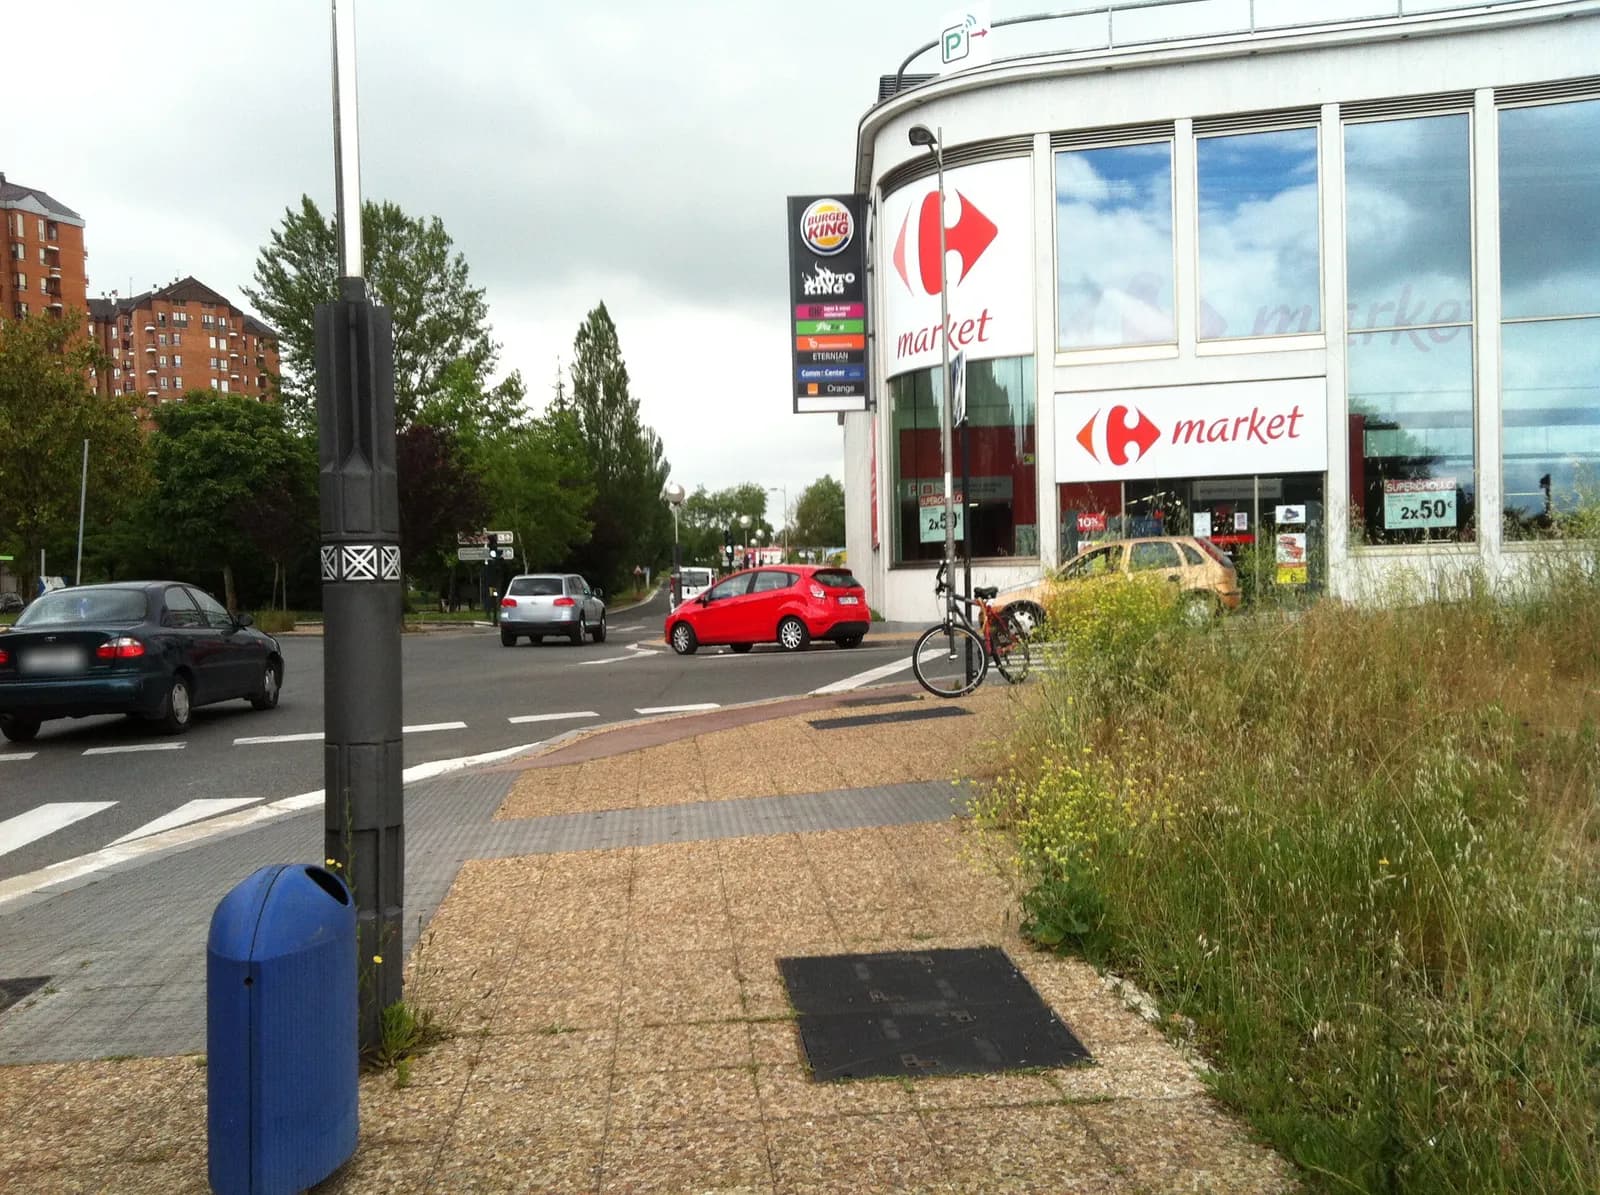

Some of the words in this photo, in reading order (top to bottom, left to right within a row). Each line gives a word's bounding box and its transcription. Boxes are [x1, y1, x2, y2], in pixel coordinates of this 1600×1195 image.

[807, 212, 849, 226] BURGER
[807, 221, 849, 241] KING
[896, 308, 993, 360] market
[827, 384, 855, 394] Orange
[1171, 404, 1304, 446] market
